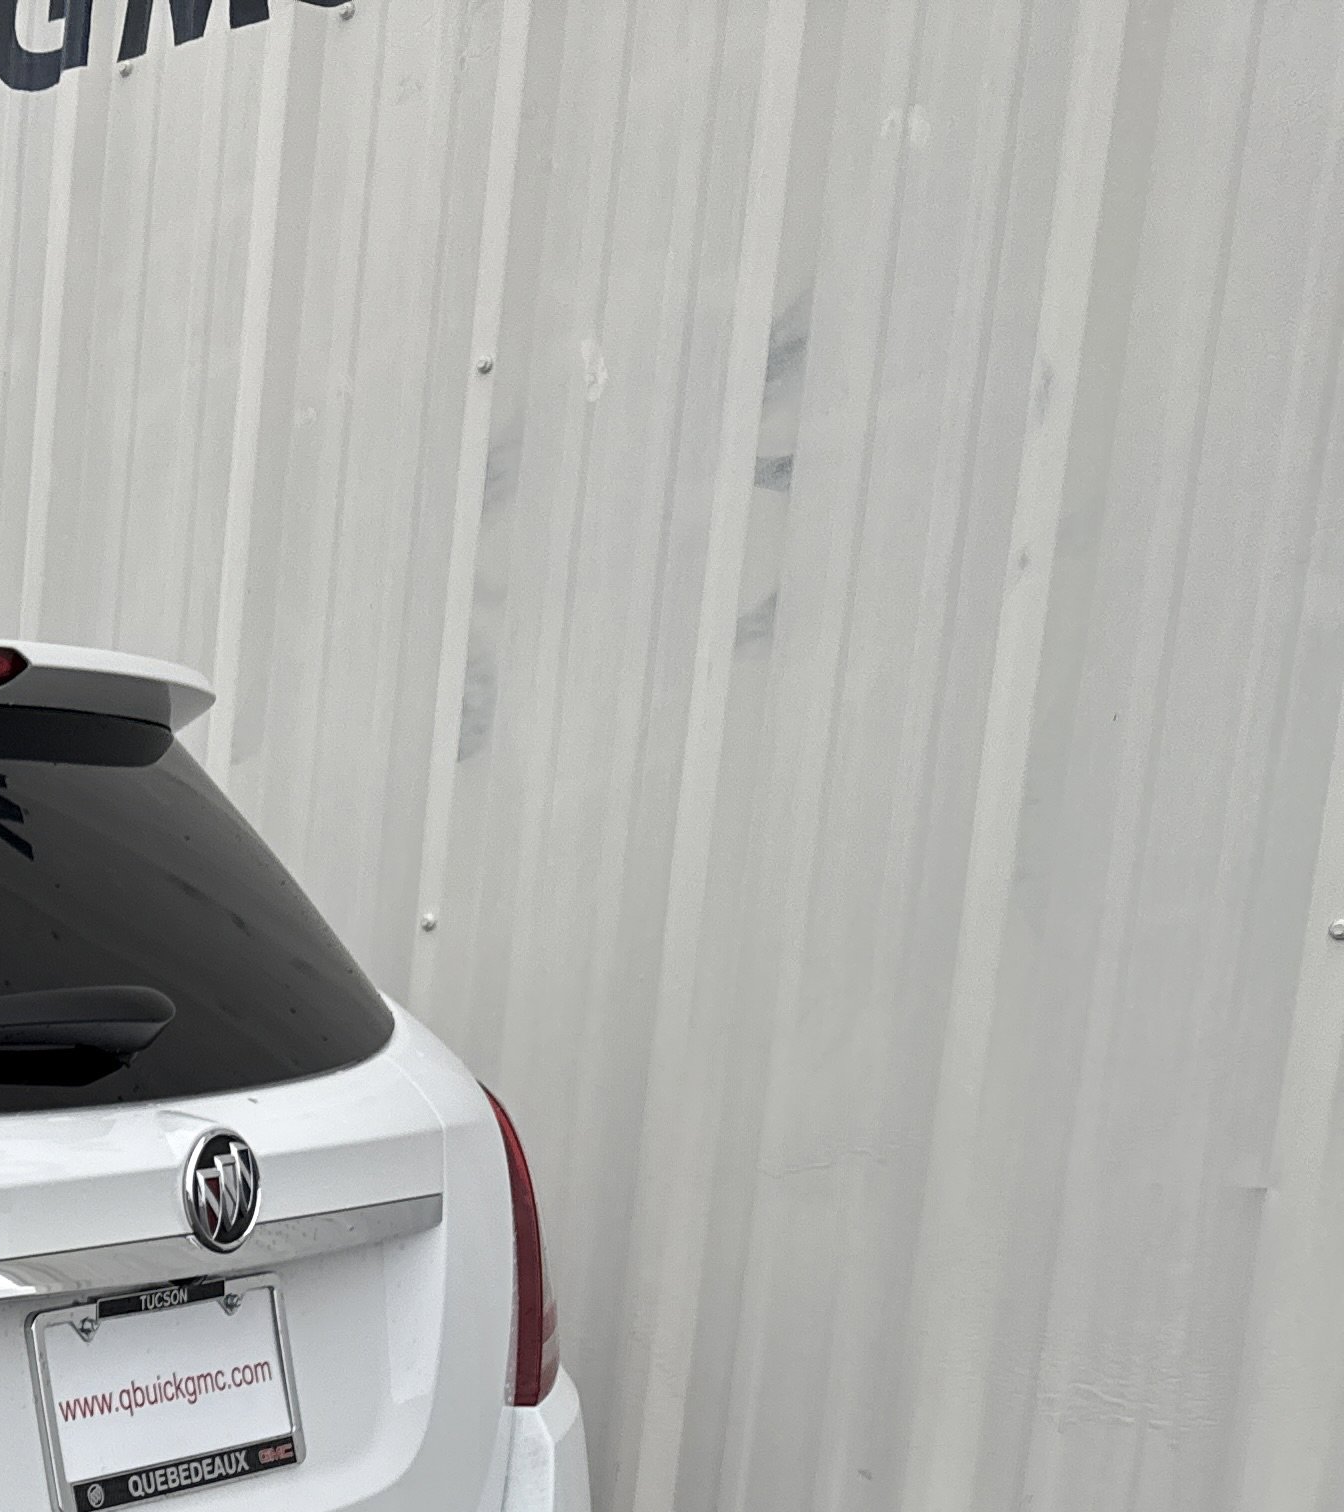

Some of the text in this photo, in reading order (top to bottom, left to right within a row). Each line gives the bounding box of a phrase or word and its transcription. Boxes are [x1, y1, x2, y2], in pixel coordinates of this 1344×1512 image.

[139, 1288, 189, 1311] TUCSON
[58, 1360, 273, 1422] www.qbuickgmc.com
[127, 1443, 295, 1498] QUEBEDEAUX GMC
